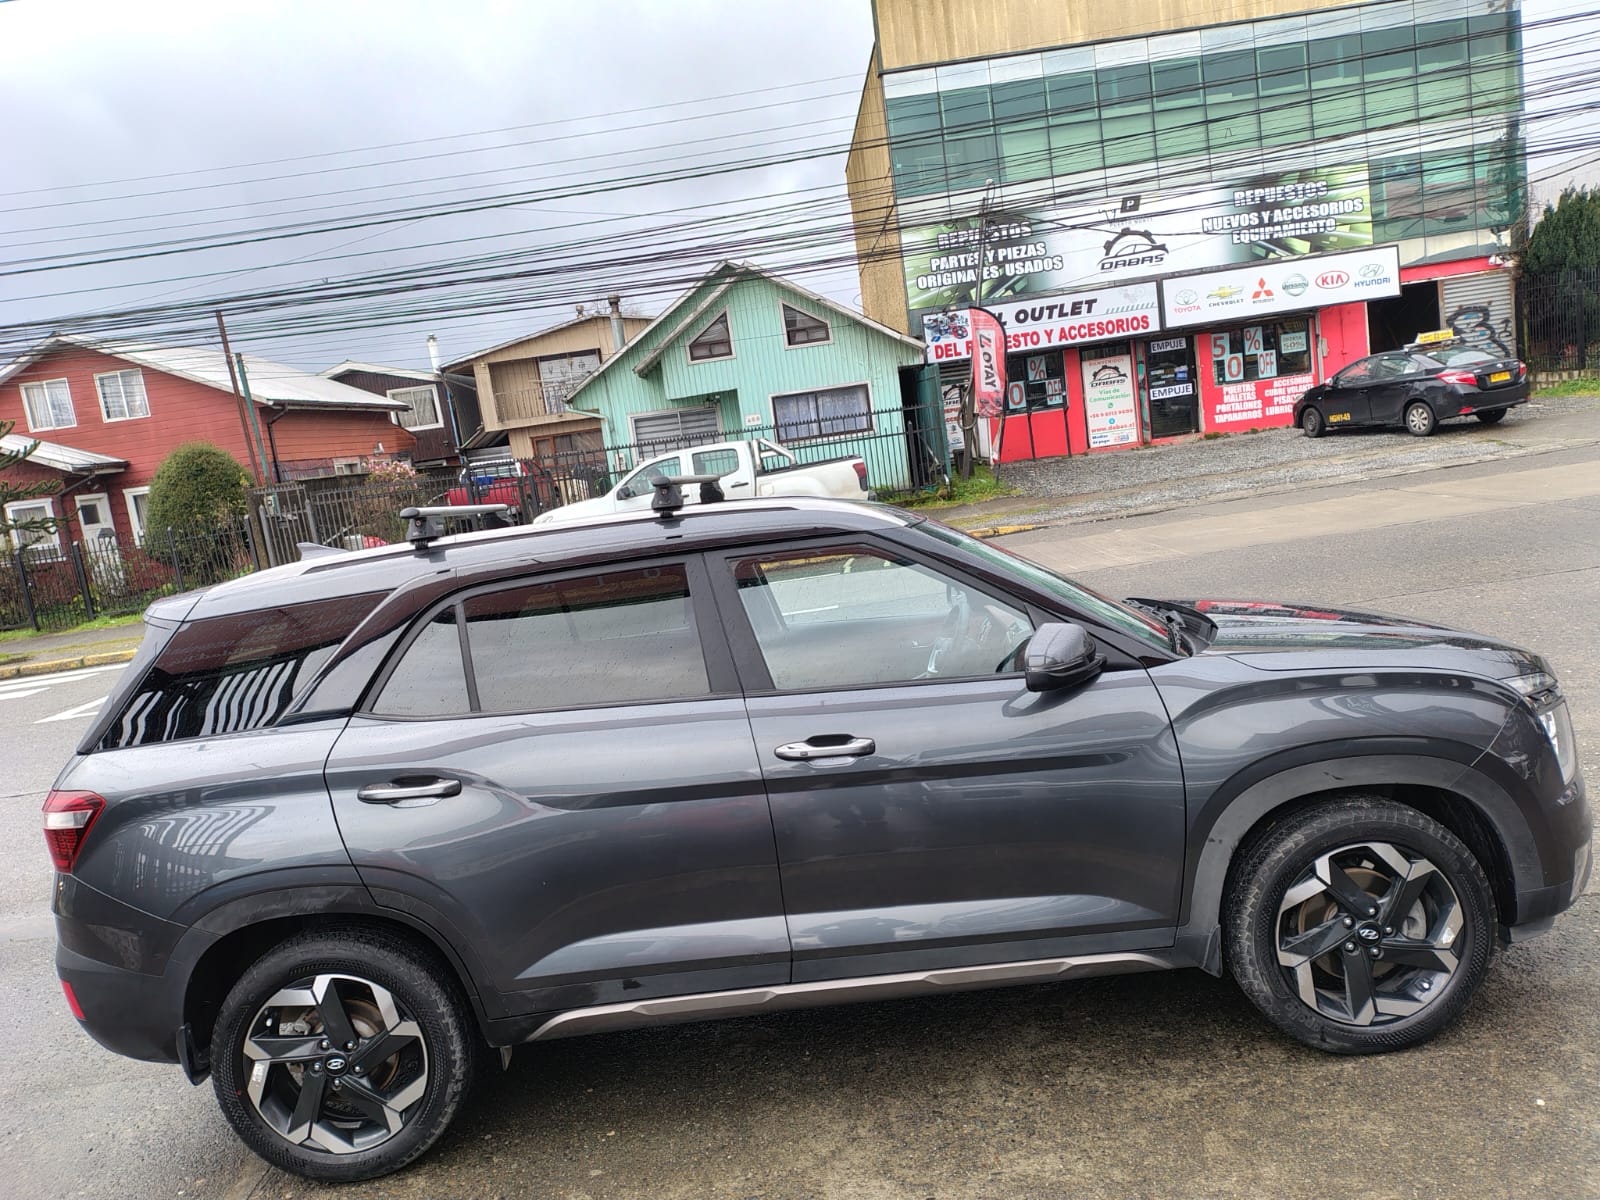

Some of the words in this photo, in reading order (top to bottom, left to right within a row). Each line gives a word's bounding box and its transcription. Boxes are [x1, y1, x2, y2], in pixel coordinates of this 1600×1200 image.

[1233, 181, 1328, 207] REPUESTOS
[1202, 212, 1259, 233] NUEVOS
[1261, 211, 1272, 224] Y
[1273, 198, 1364, 223] ACCESORIOS
[1232, 218, 1336, 244] EQUIPAMIENTO
[930, 252, 980, 272] PARTES
[985, 249, 997, 264] Y
[999, 241, 1046, 262] PIEZAS
[1100, 253, 1165, 271] DABAS
[1005, 255, 1063, 277] USADOS
[1321, 274, 1344, 286] KIA
[1354, 277, 1391, 288] HYUNDAI
[1174, 305, 1201, 314] TOYOTA
[1208, 298, 1244, 308] CHEVROLET
[994, 311, 1008, 326] L
[1014, 298, 1097, 324] OUTLET
[935, 342, 962, 360] DEL
[1045, 328, 1058, 343] Y
[1059, 315, 1150, 342] ACCESORIOS
[1152, 338, 1185, 352] EMPUJE
[1212, 335, 1226, 358] 5
[1227, 356, 1242, 378] 0
[1245, 328, 1261, 352] %
[1258, 352, 1274, 375] OFF
[1010, 383, 1024, 406] 0
[1030, 359, 1046, 380] %
[1223, 382, 1256, 395] PUERTAS
[1152, 384, 1191, 398] EMPUJE
[1223, 391, 1256, 403] MALETAS
[1216, 400, 1262, 413] PORTALONES
[1265, 404, 1293, 416] LUBRIC
